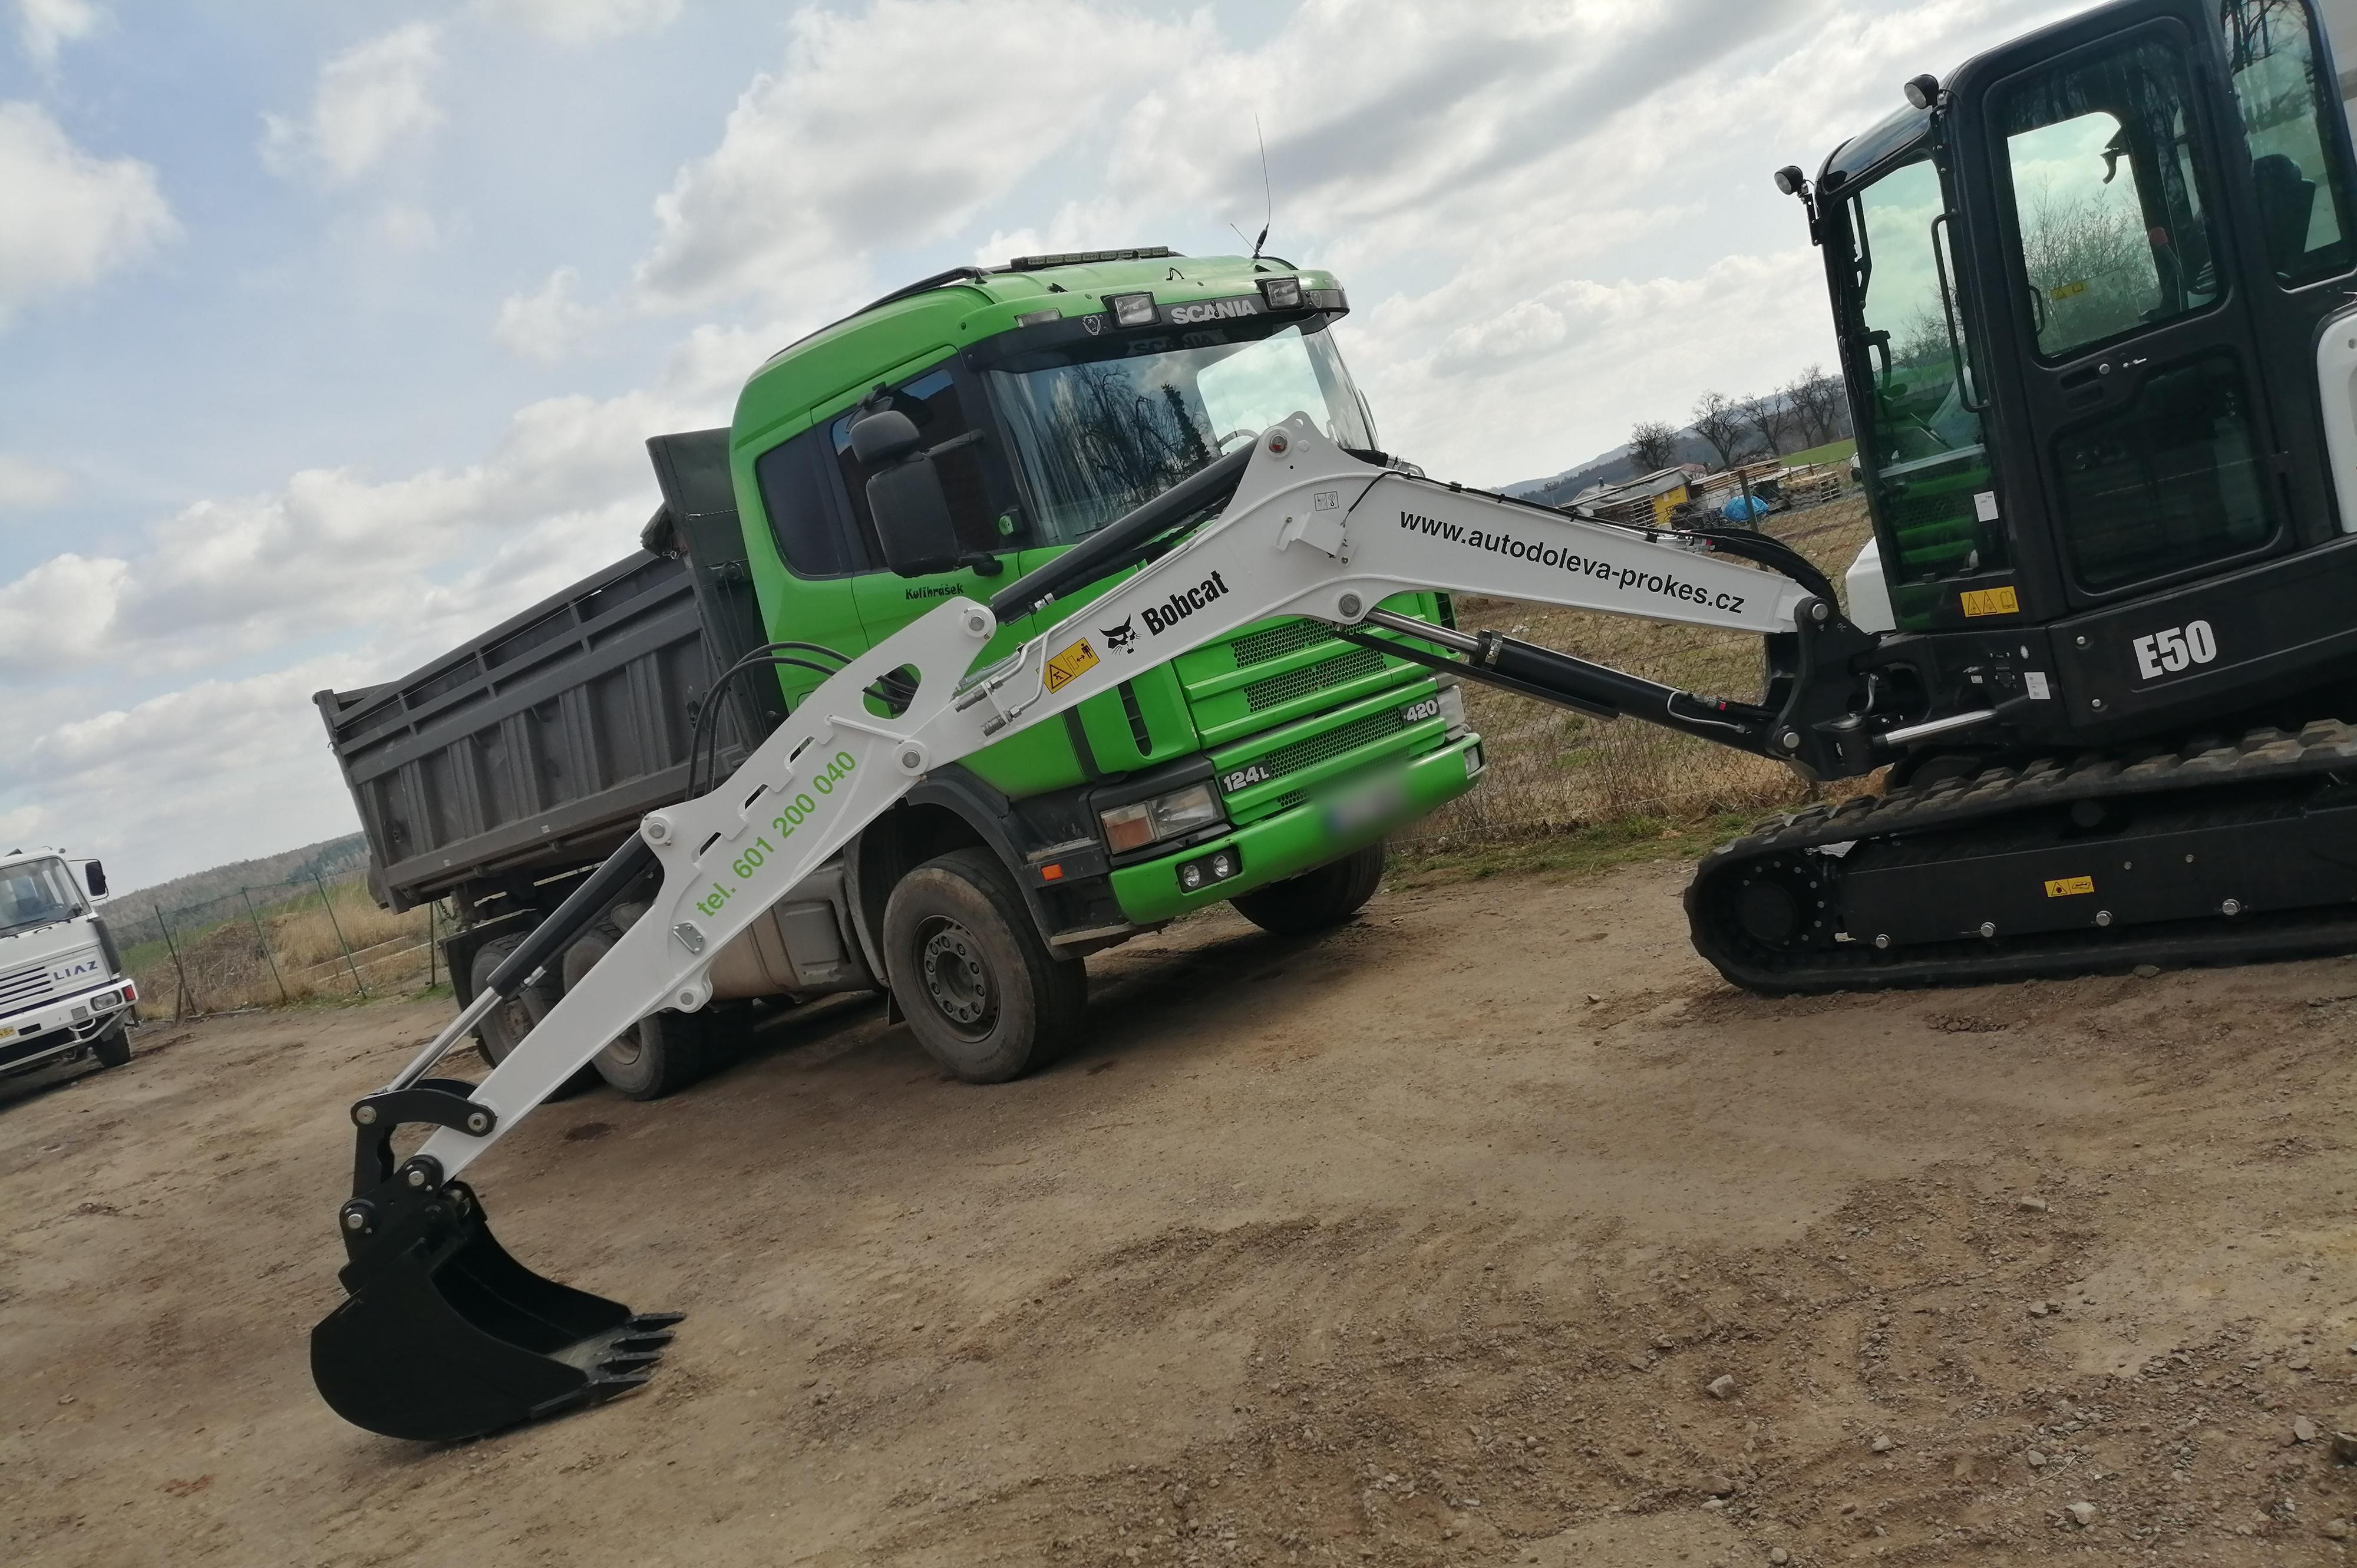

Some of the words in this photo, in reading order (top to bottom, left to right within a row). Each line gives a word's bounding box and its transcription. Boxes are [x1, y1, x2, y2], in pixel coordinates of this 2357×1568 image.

[1171, 299, 1257, 324] SCANIA
[1400, 511, 1745, 613] www.autodoleva-prokes.cz
[1141, 570, 1229, 636] Bobcat
[2132, 620, 2217, 679] E50
[1407, 700, 1438, 721] 420
[696, 883, 737, 916] tel.
[732, 836, 774, 879] 601
[773, 793, 816, 839] 200
[813, 751, 856, 794] 040
[53, 960, 98, 981] LIAZ
